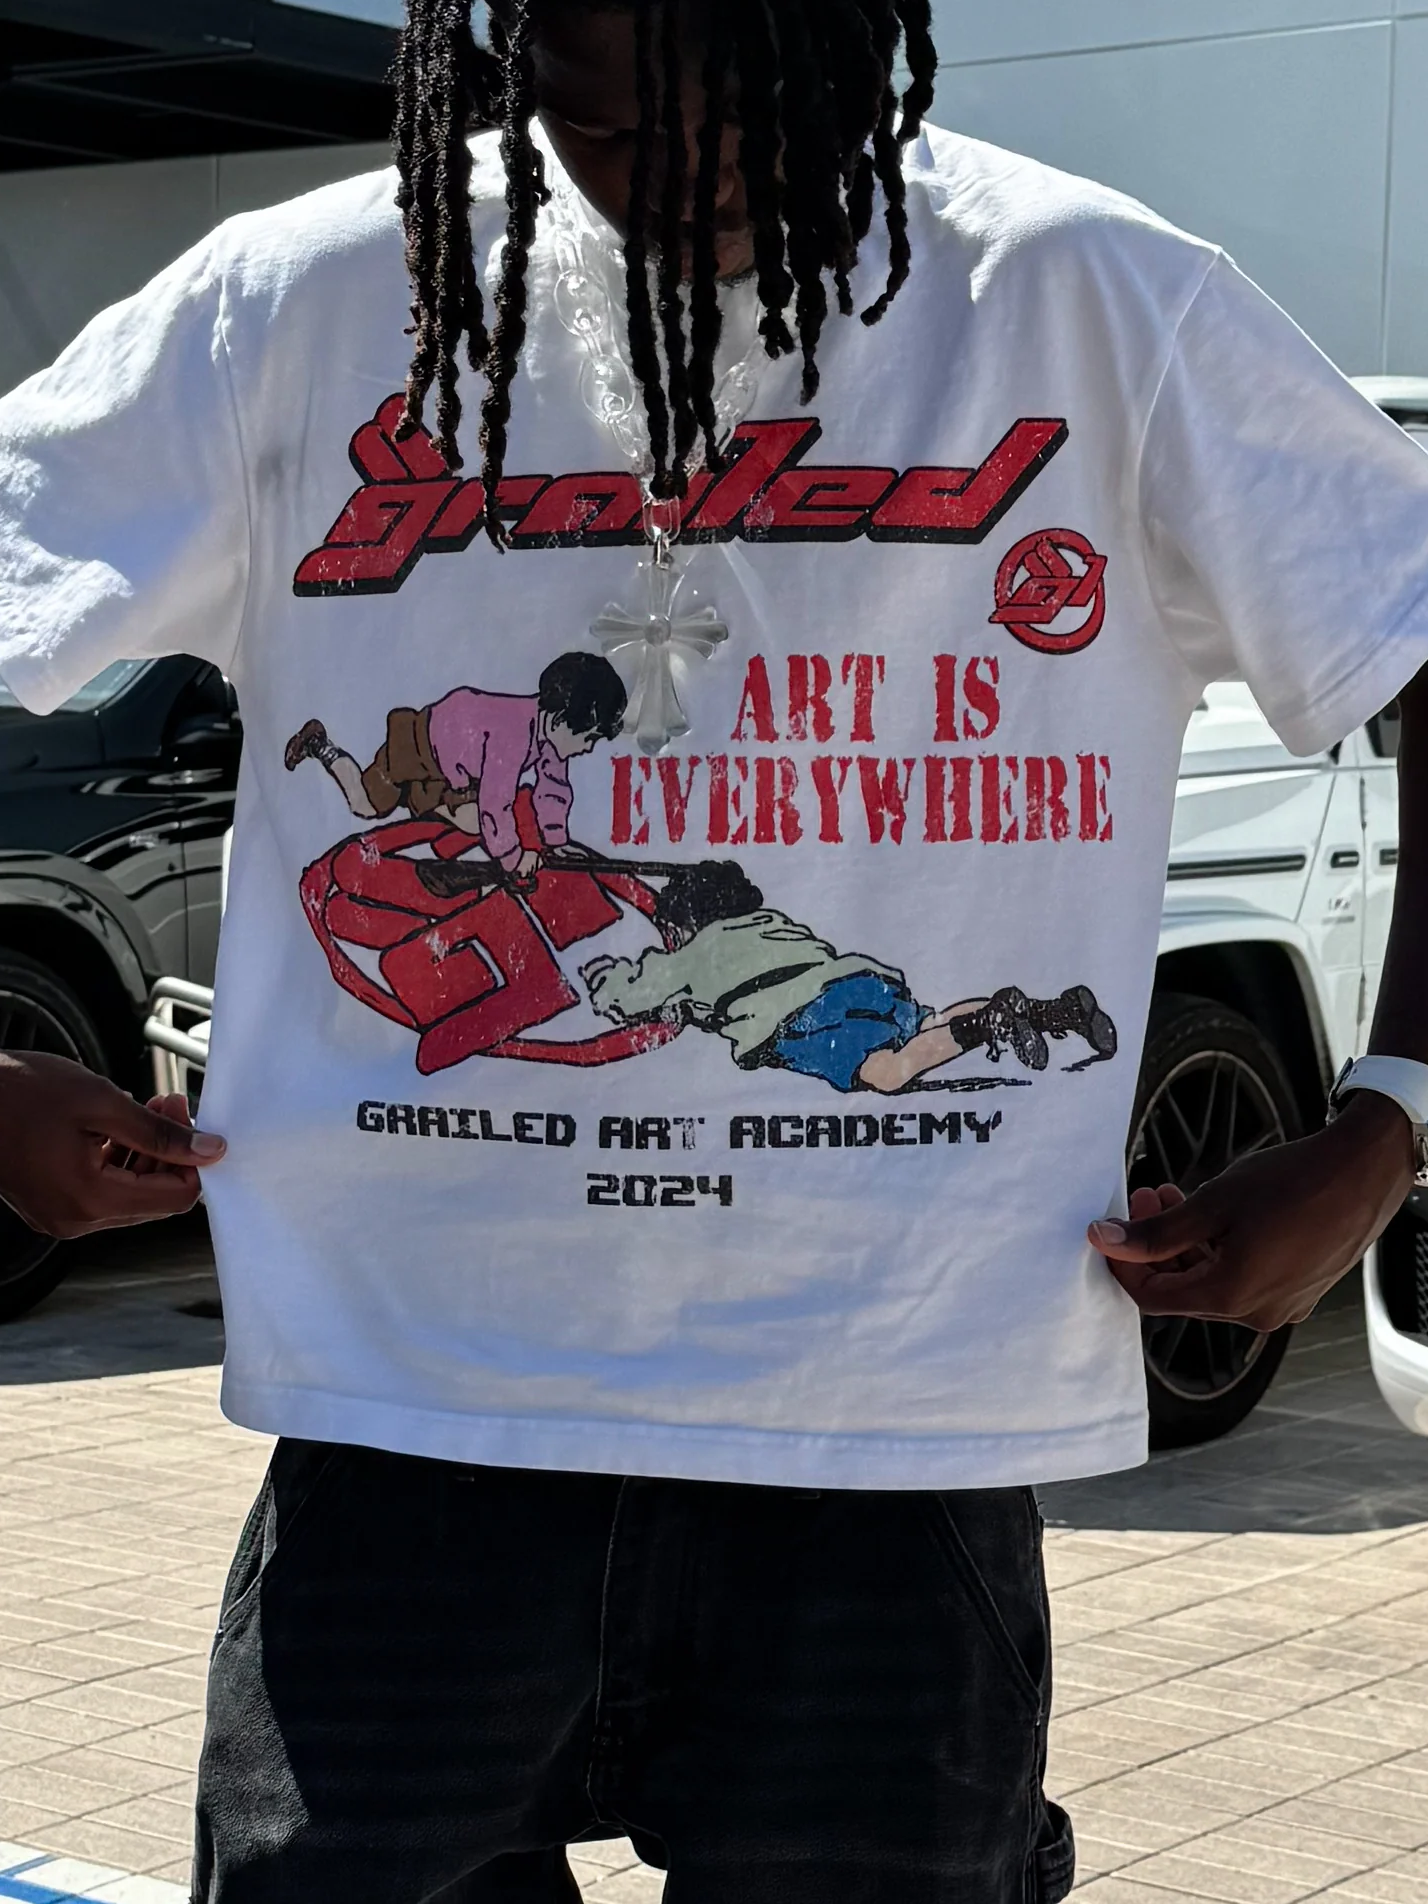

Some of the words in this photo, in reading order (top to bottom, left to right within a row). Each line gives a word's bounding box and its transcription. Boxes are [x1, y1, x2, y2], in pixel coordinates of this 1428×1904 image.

[730, 653, 885, 744] ART
[933, 653, 1001, 743] IS
[609, 751, 1113, 846] EVERYWHERE
[356, 1100, 577, 1148] GRAILED
[598, 1117, 704, 1150] ART
[729, 1111, 1003, 1149] ACADEMY
[586, 1173, 734, 1207] 2024
